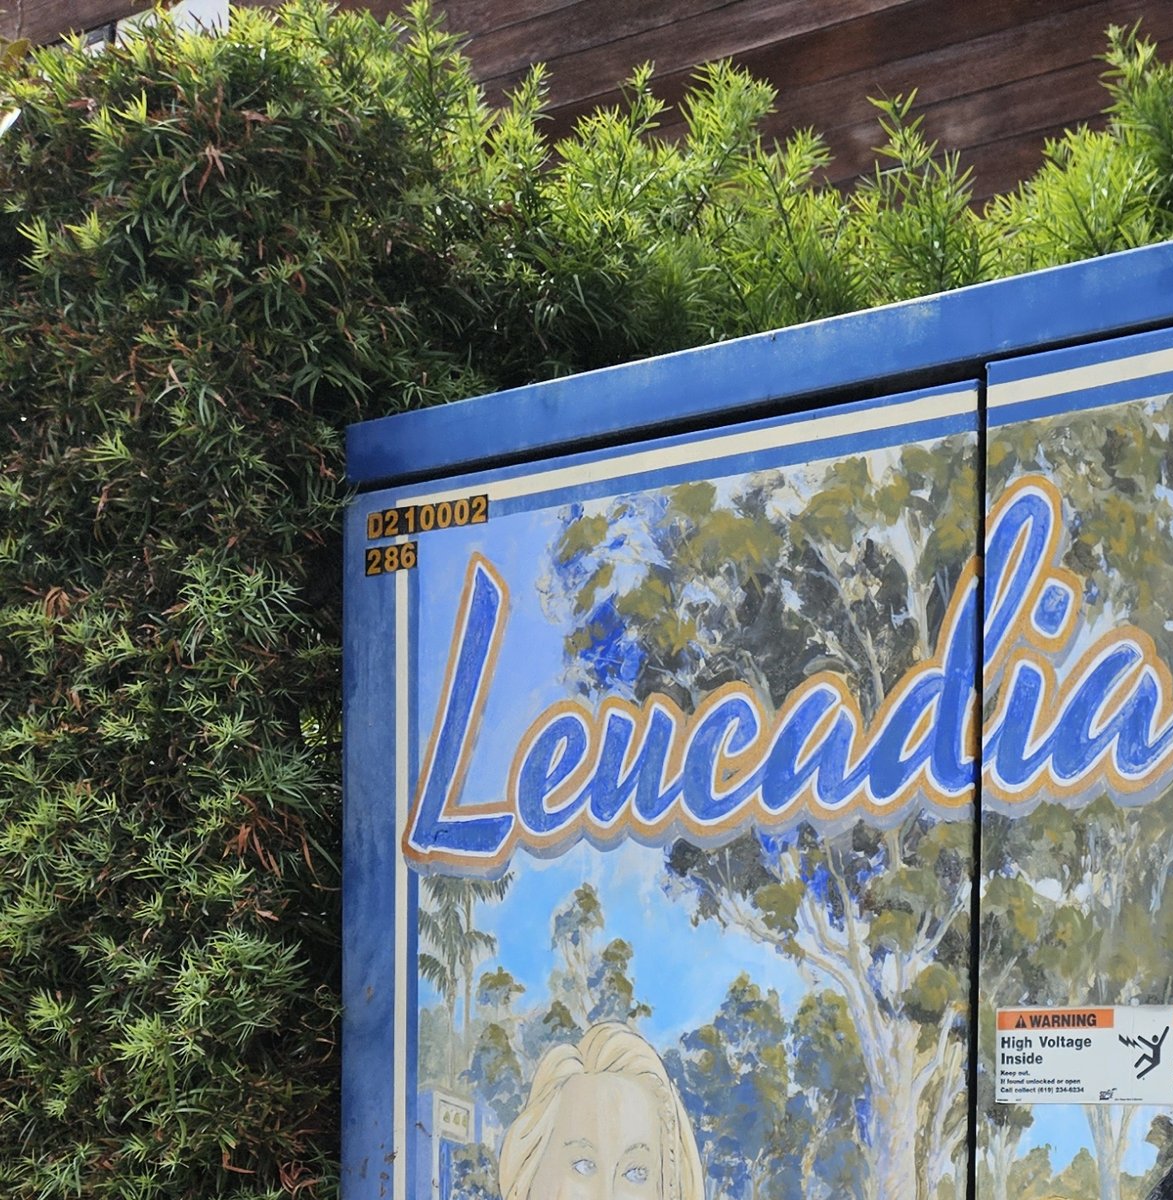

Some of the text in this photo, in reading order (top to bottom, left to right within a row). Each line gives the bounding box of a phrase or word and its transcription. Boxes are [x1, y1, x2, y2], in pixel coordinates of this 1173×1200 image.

[368, 496, 487, 540] D210002
[366, 542, 416, 575] 286
[1029, 1014, 1097, 1028] WARNING
[1001, 1035, 1092, 1051] High Voltage
[1001, 1052, 1043, 1065] Inside
